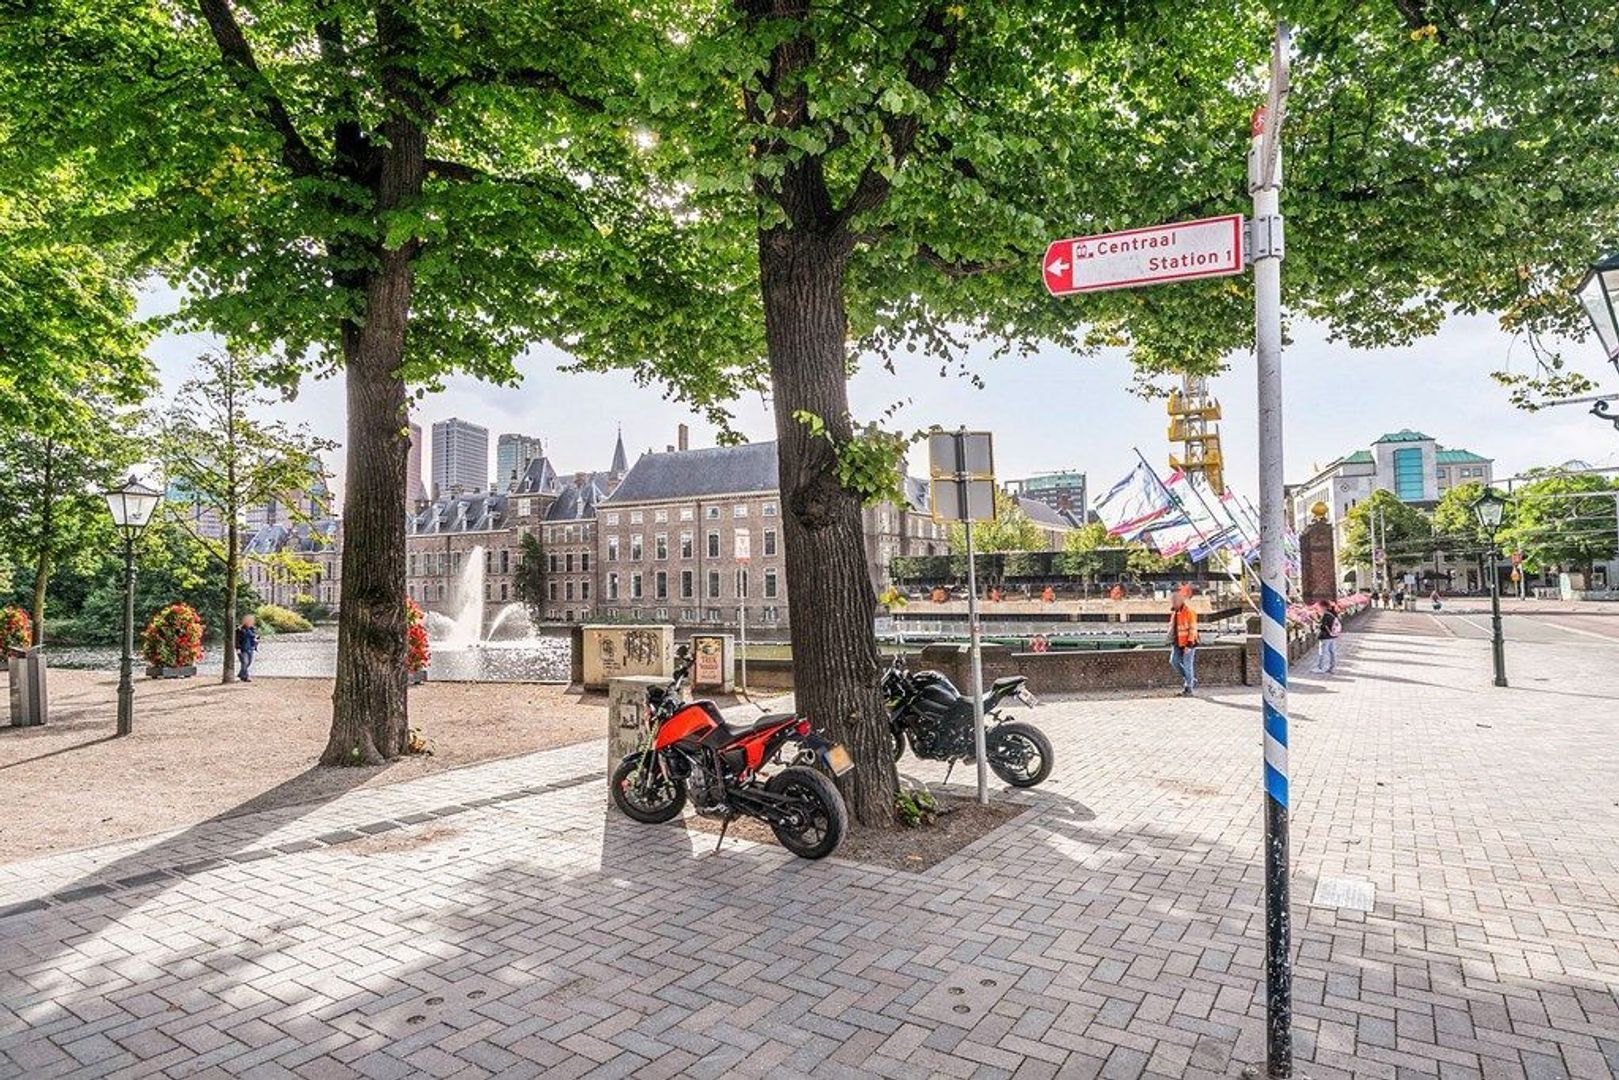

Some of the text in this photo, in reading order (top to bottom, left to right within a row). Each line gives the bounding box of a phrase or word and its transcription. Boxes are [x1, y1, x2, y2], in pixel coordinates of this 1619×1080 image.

[1097, 232, 1176, 255] Centraal
[1149, 250, 1232, 271] Station 1
